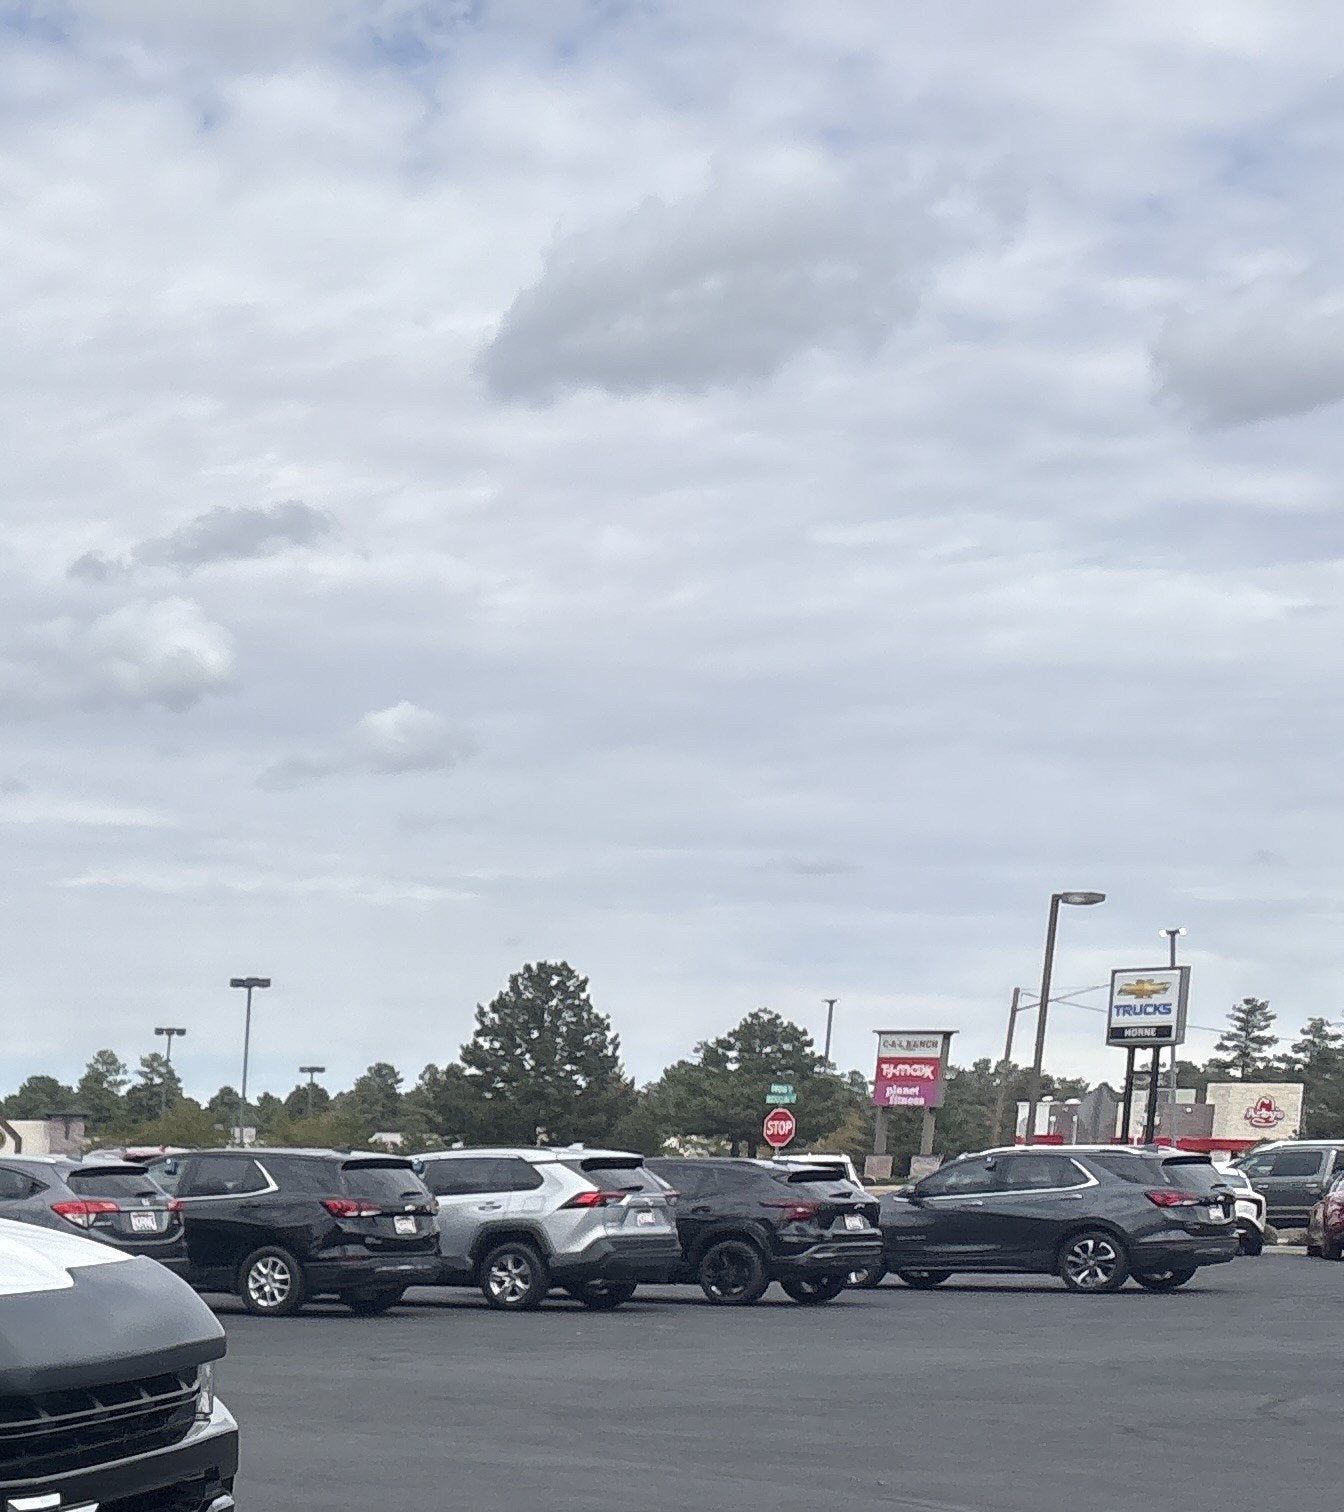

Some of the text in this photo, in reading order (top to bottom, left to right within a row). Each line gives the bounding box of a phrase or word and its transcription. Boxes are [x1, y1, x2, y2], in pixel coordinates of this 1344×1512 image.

[1114, 1003, 1172, 1017] TRUCKS
[1124, 1028, 1157, 1037] HORNE
[906, 1040, 938, 1049] RANCH
[885, 1085, 920, 1098] planet
[766, 1120, 792, 1135] STOP
